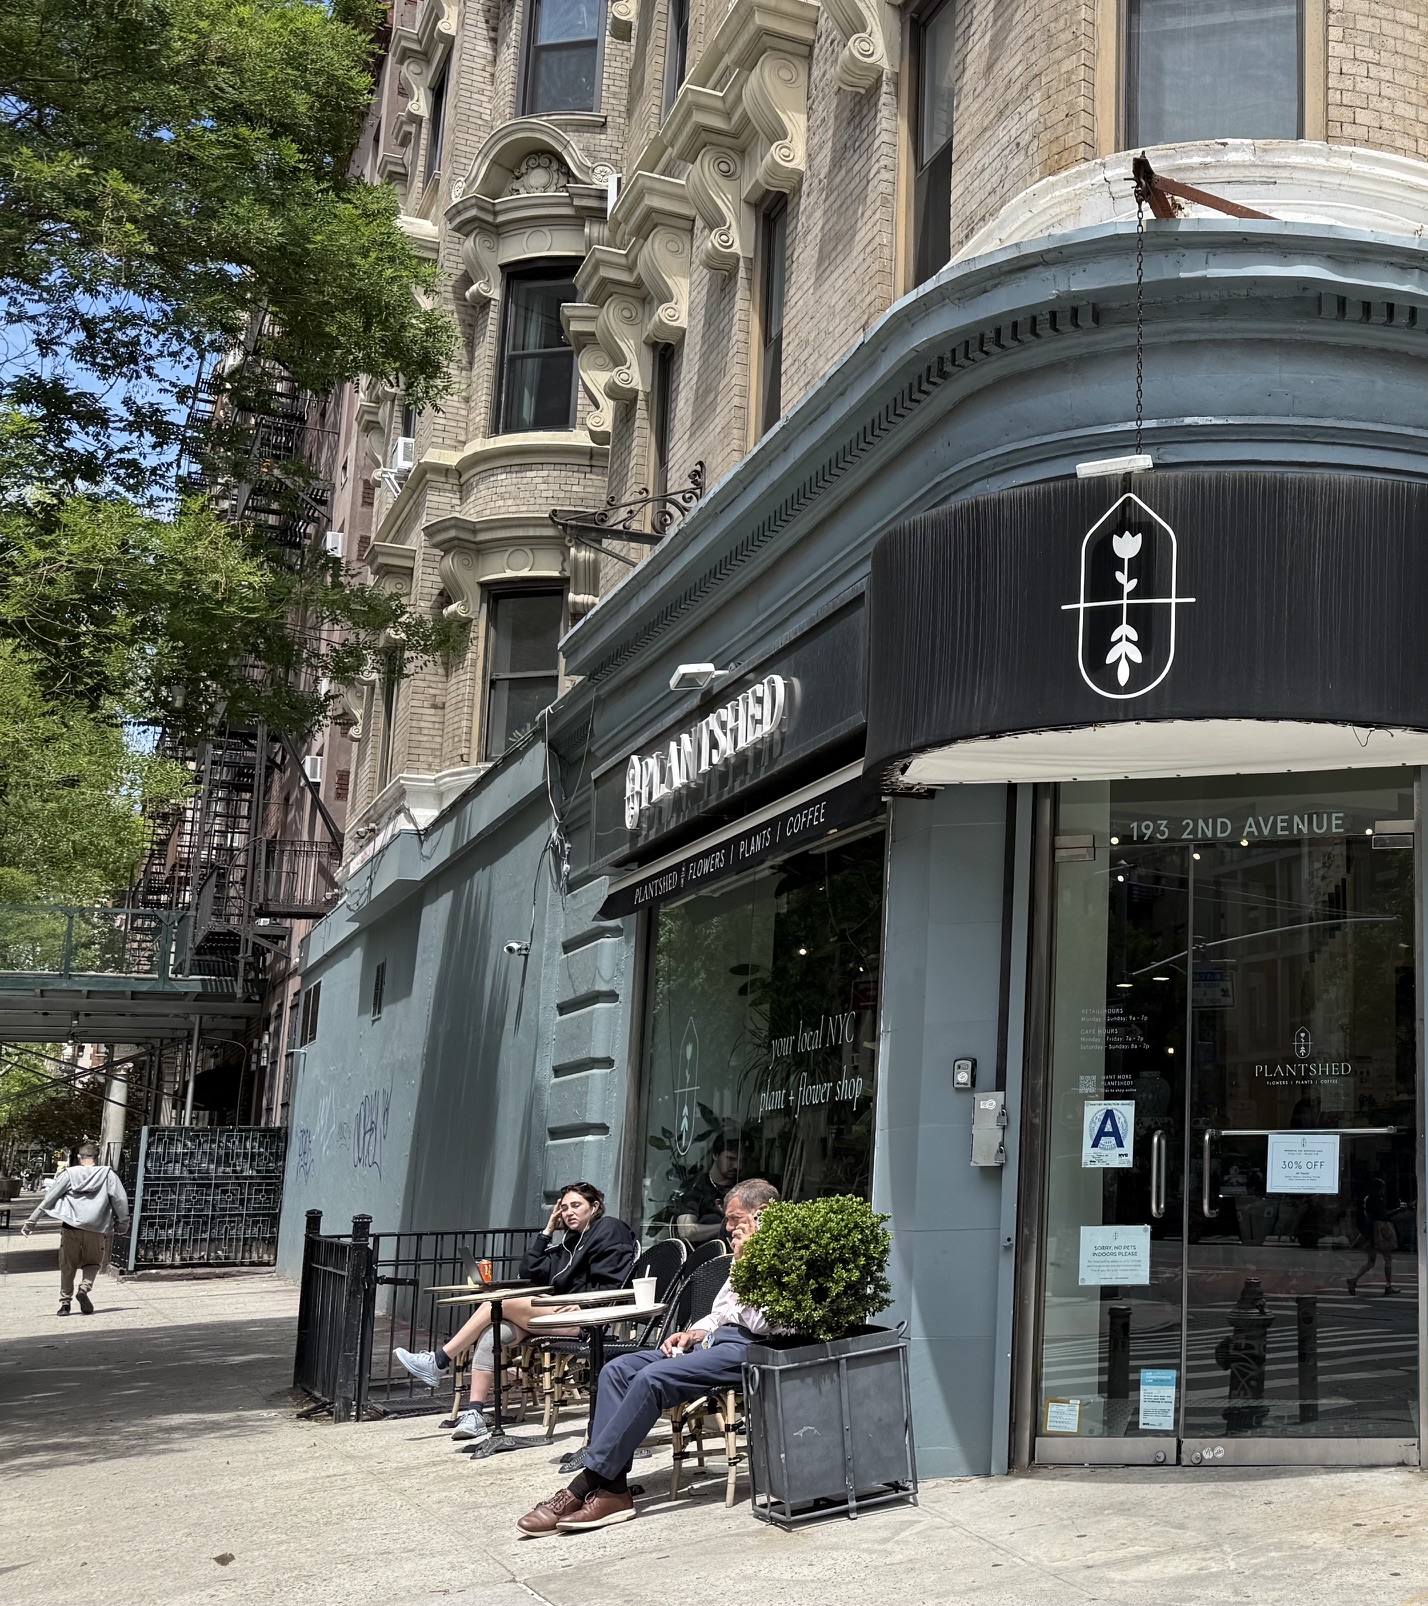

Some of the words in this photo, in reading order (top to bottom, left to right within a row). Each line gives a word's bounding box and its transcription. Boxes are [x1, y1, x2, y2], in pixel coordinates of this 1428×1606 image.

[640, 674, 785, 810] PLANTSHED
[1129, 819, 1169, 841] 193
[1181, 817, 1232, 839] 2ND
[1242, 812, 1345, 837] AVENUE
[633, 871, 678, 905] PLANTSHED
[688, 849, 725, 880] FLOWERS
[739, 827, 771, 860] PLANTS
[786, 801, 827, 837] COFFEE
[768, 1035, 796, 1070] your
[797, 1014, 825, 1053] local
[826, 1010, 856, 1047] NYC
[757, 1078, 787, 1123] plant
[794, 1071, 833, 1119] flower
[835, 1064, 863, 1112] shop
[1255, 1062, 1352, 1077] PLANTSHED
[1091, 1109, 1125, 1148] A
[1281, 1160, 1303, 1170] 30%
[1305, 1160, 1325, 1170] OFF
